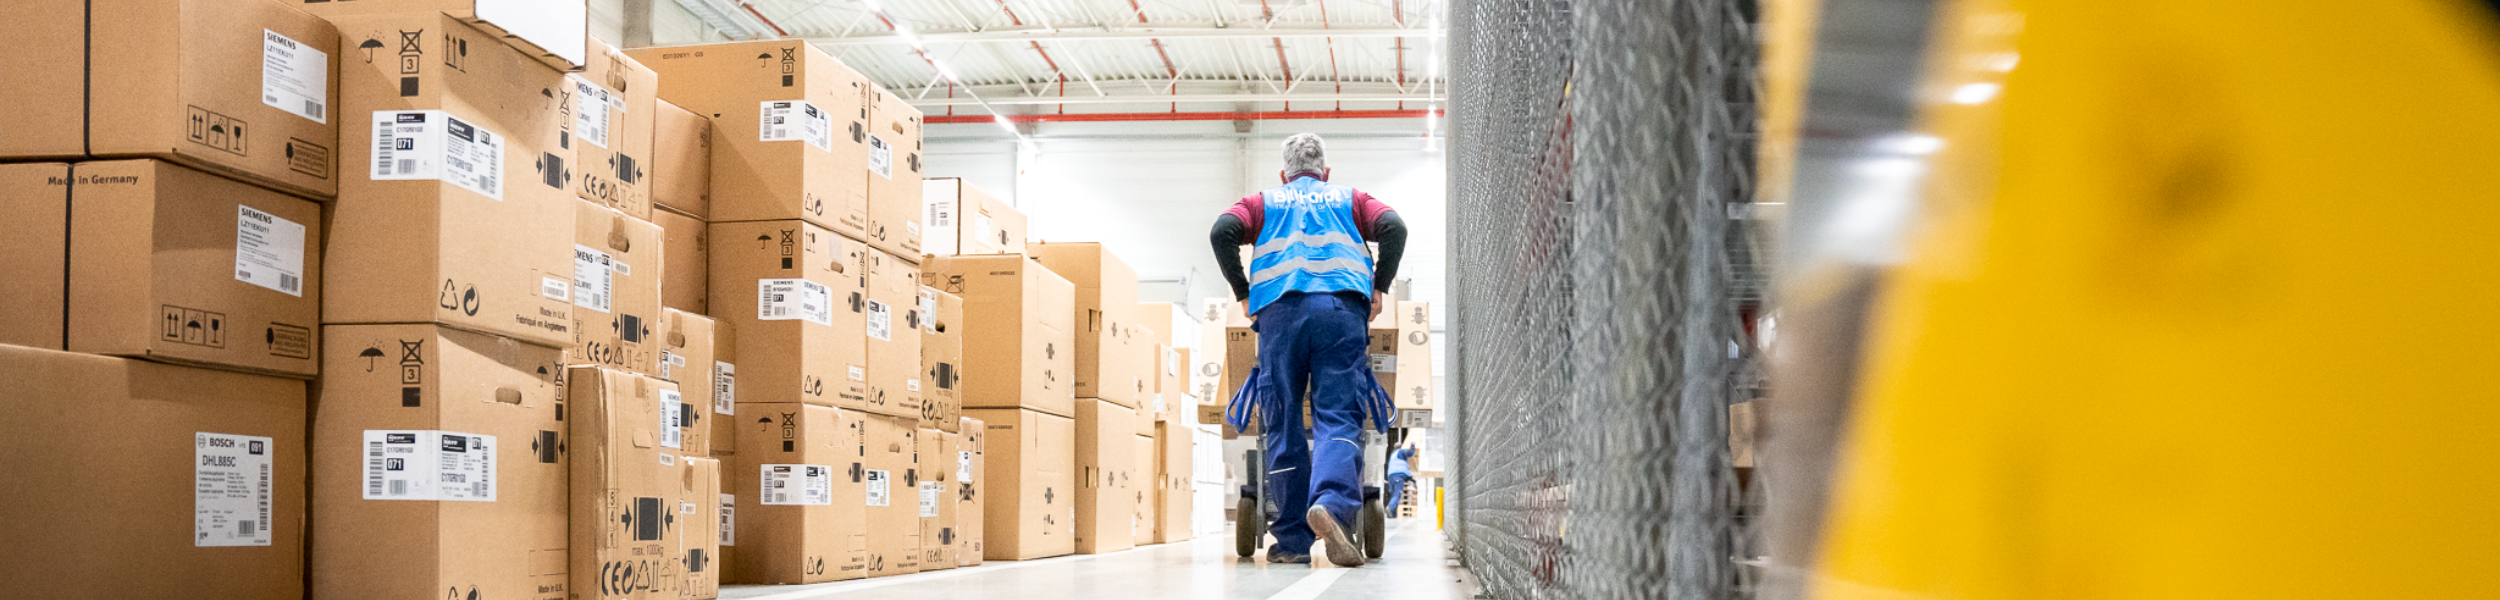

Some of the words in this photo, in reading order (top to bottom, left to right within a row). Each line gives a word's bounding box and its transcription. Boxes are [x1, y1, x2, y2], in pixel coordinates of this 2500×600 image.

[266, 32, 296, 50] SIEMENS
[407, 58, 414, 70] 3
[397, 138, 411, 149] 071
[78, 175, 89, 185] in
[91, 174, 139, 186] Germany
[241, 207, 273, 225] SIEMENS
[408, 368, 415, 381] 3
[209, 437, 235, 448] BOSCH
[202, 454, 237, 468] DHL885C
[387, 458, 402, 470] 071
